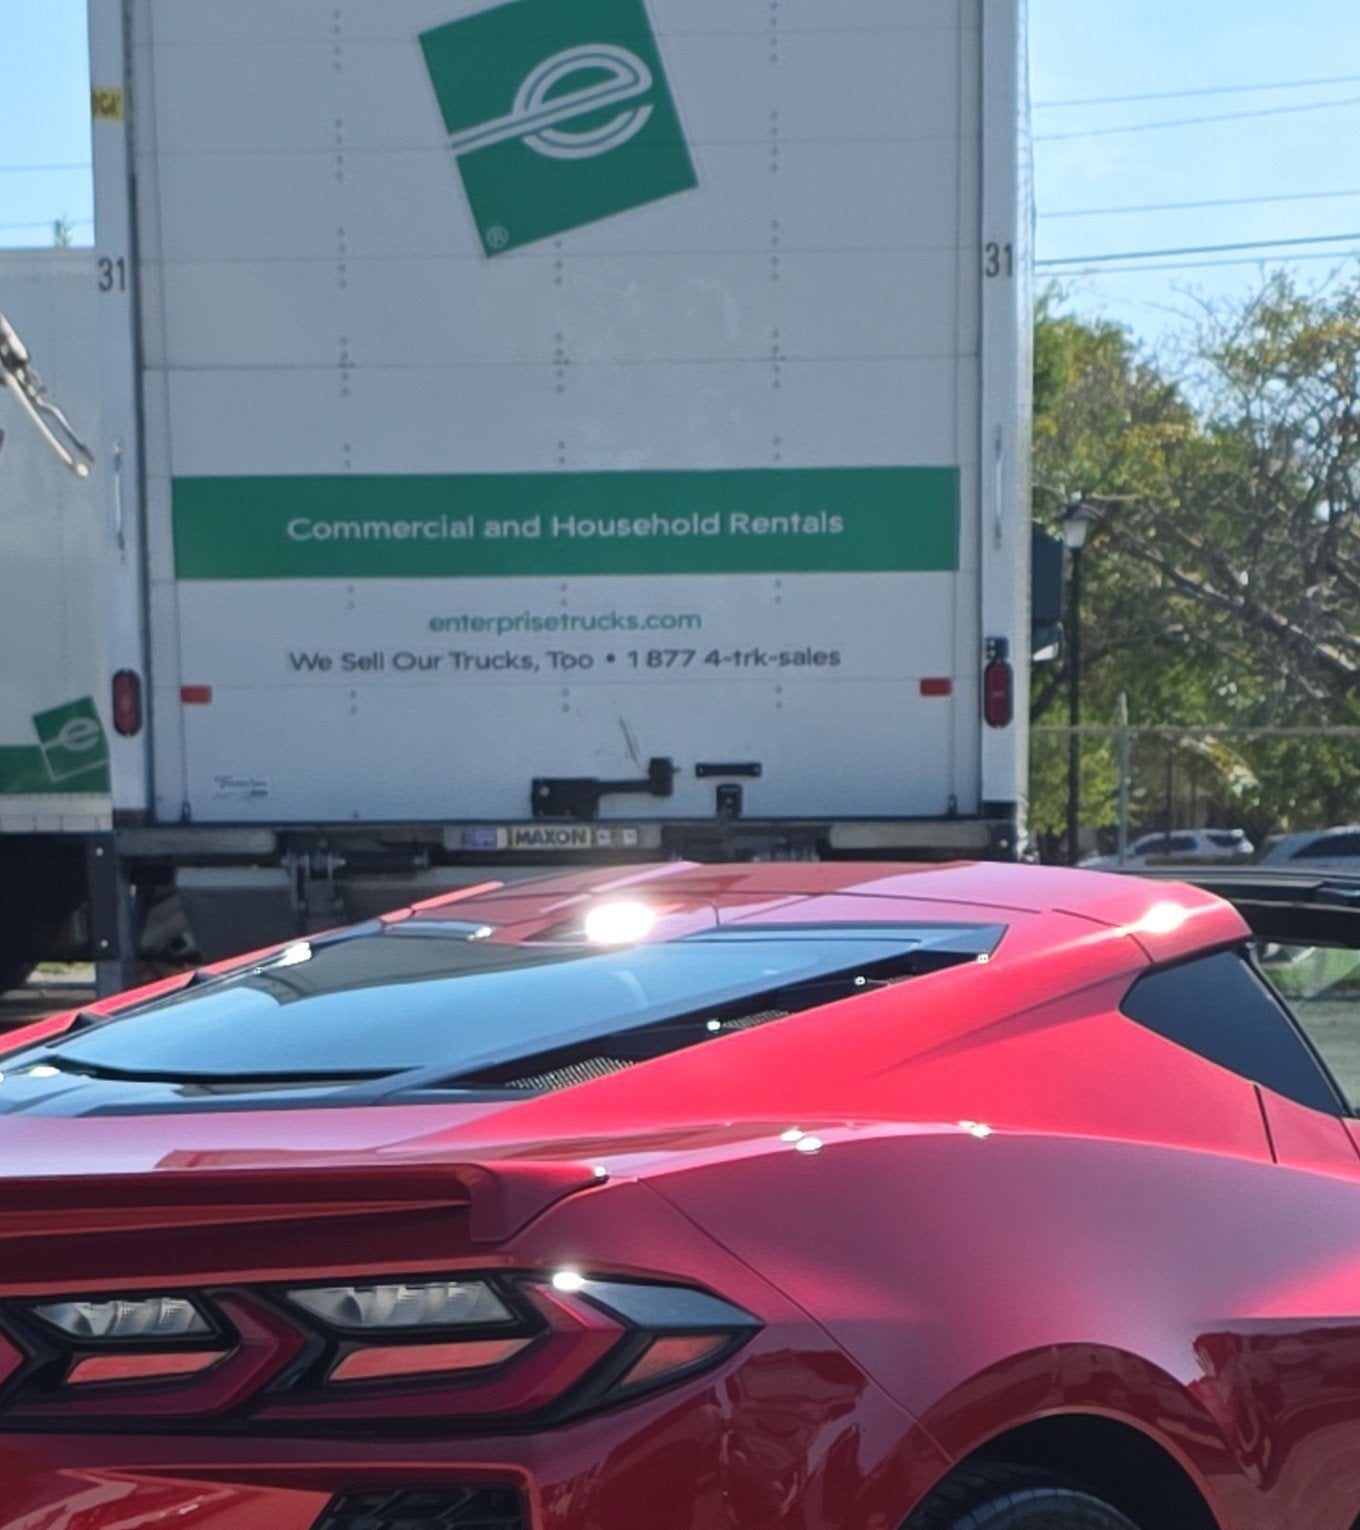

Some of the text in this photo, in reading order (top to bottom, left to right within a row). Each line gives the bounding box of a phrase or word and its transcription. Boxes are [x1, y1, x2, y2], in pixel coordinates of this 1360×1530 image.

[985, 241, 1014, 278] 31
[97, 256, 126, 292] 31
[286, 510, 844, 541] Commercial and Household Rentals
[428, 611, 702, 636] enterprisetrucks.com
[290, 647, 842, 673] We Sell Our Trucks, Too 1 877 4-trk-sales
[516, 828, 588, 845] MAXON
